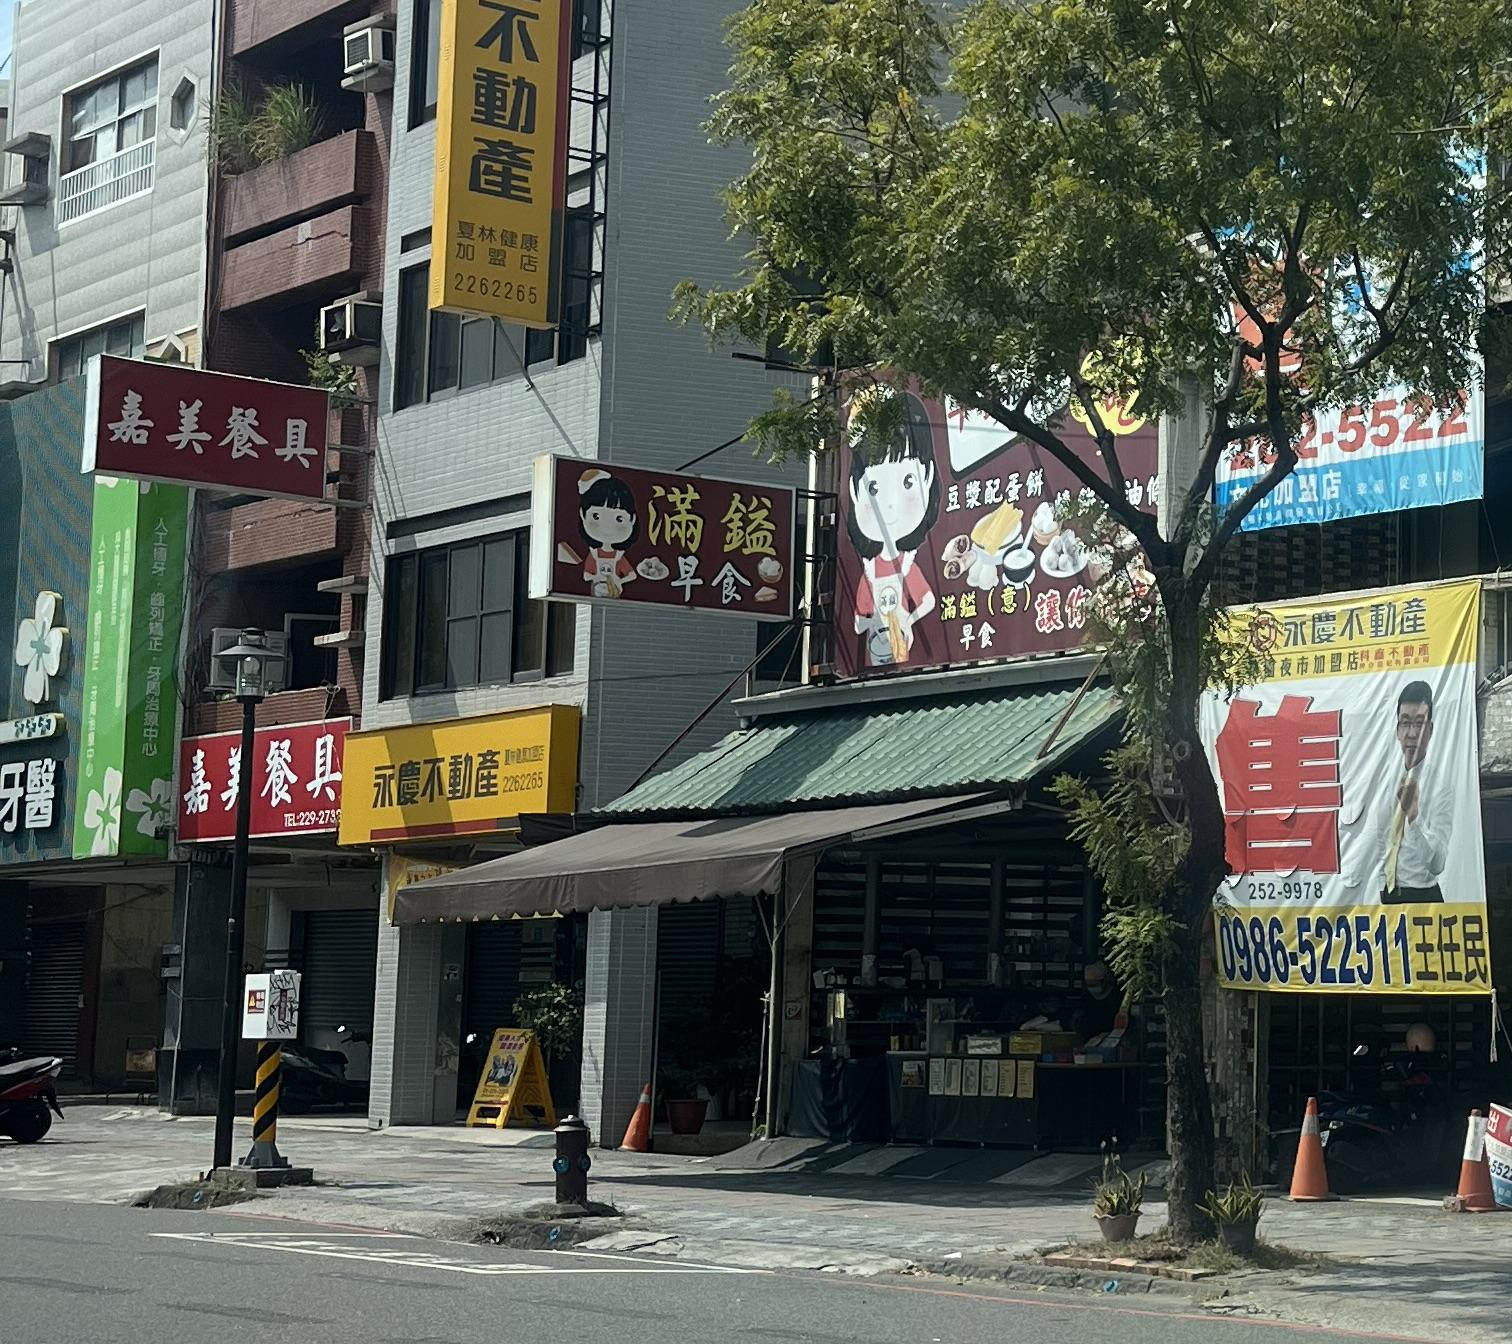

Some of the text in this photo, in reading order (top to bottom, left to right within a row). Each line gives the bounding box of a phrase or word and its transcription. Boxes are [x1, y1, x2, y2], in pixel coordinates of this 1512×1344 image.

[455, 242, 538, 273] 加盟店
[456, 220, 539, 253] 夏林健康
[454, 272, 537, 305] 2262265
[107, 389, 319, 469] 嘉美餐具
[946, 467, 1044, 513] 豆漿配蛋餅
[648, 483, 777, 556] 滿鎰
[671, 555, 752, 605] 早食
[959, 621, 996, 651] 早食
[1283, 597, 1428, 647] 永慶不動產
[372, 749, 501, 808] 永慶不動產
[1216, 694, 1342, 876] 售
[1248, 881, 1323, 900] 252-9978
[1219, 912, 1488, 985] 0986-522511 王任民
